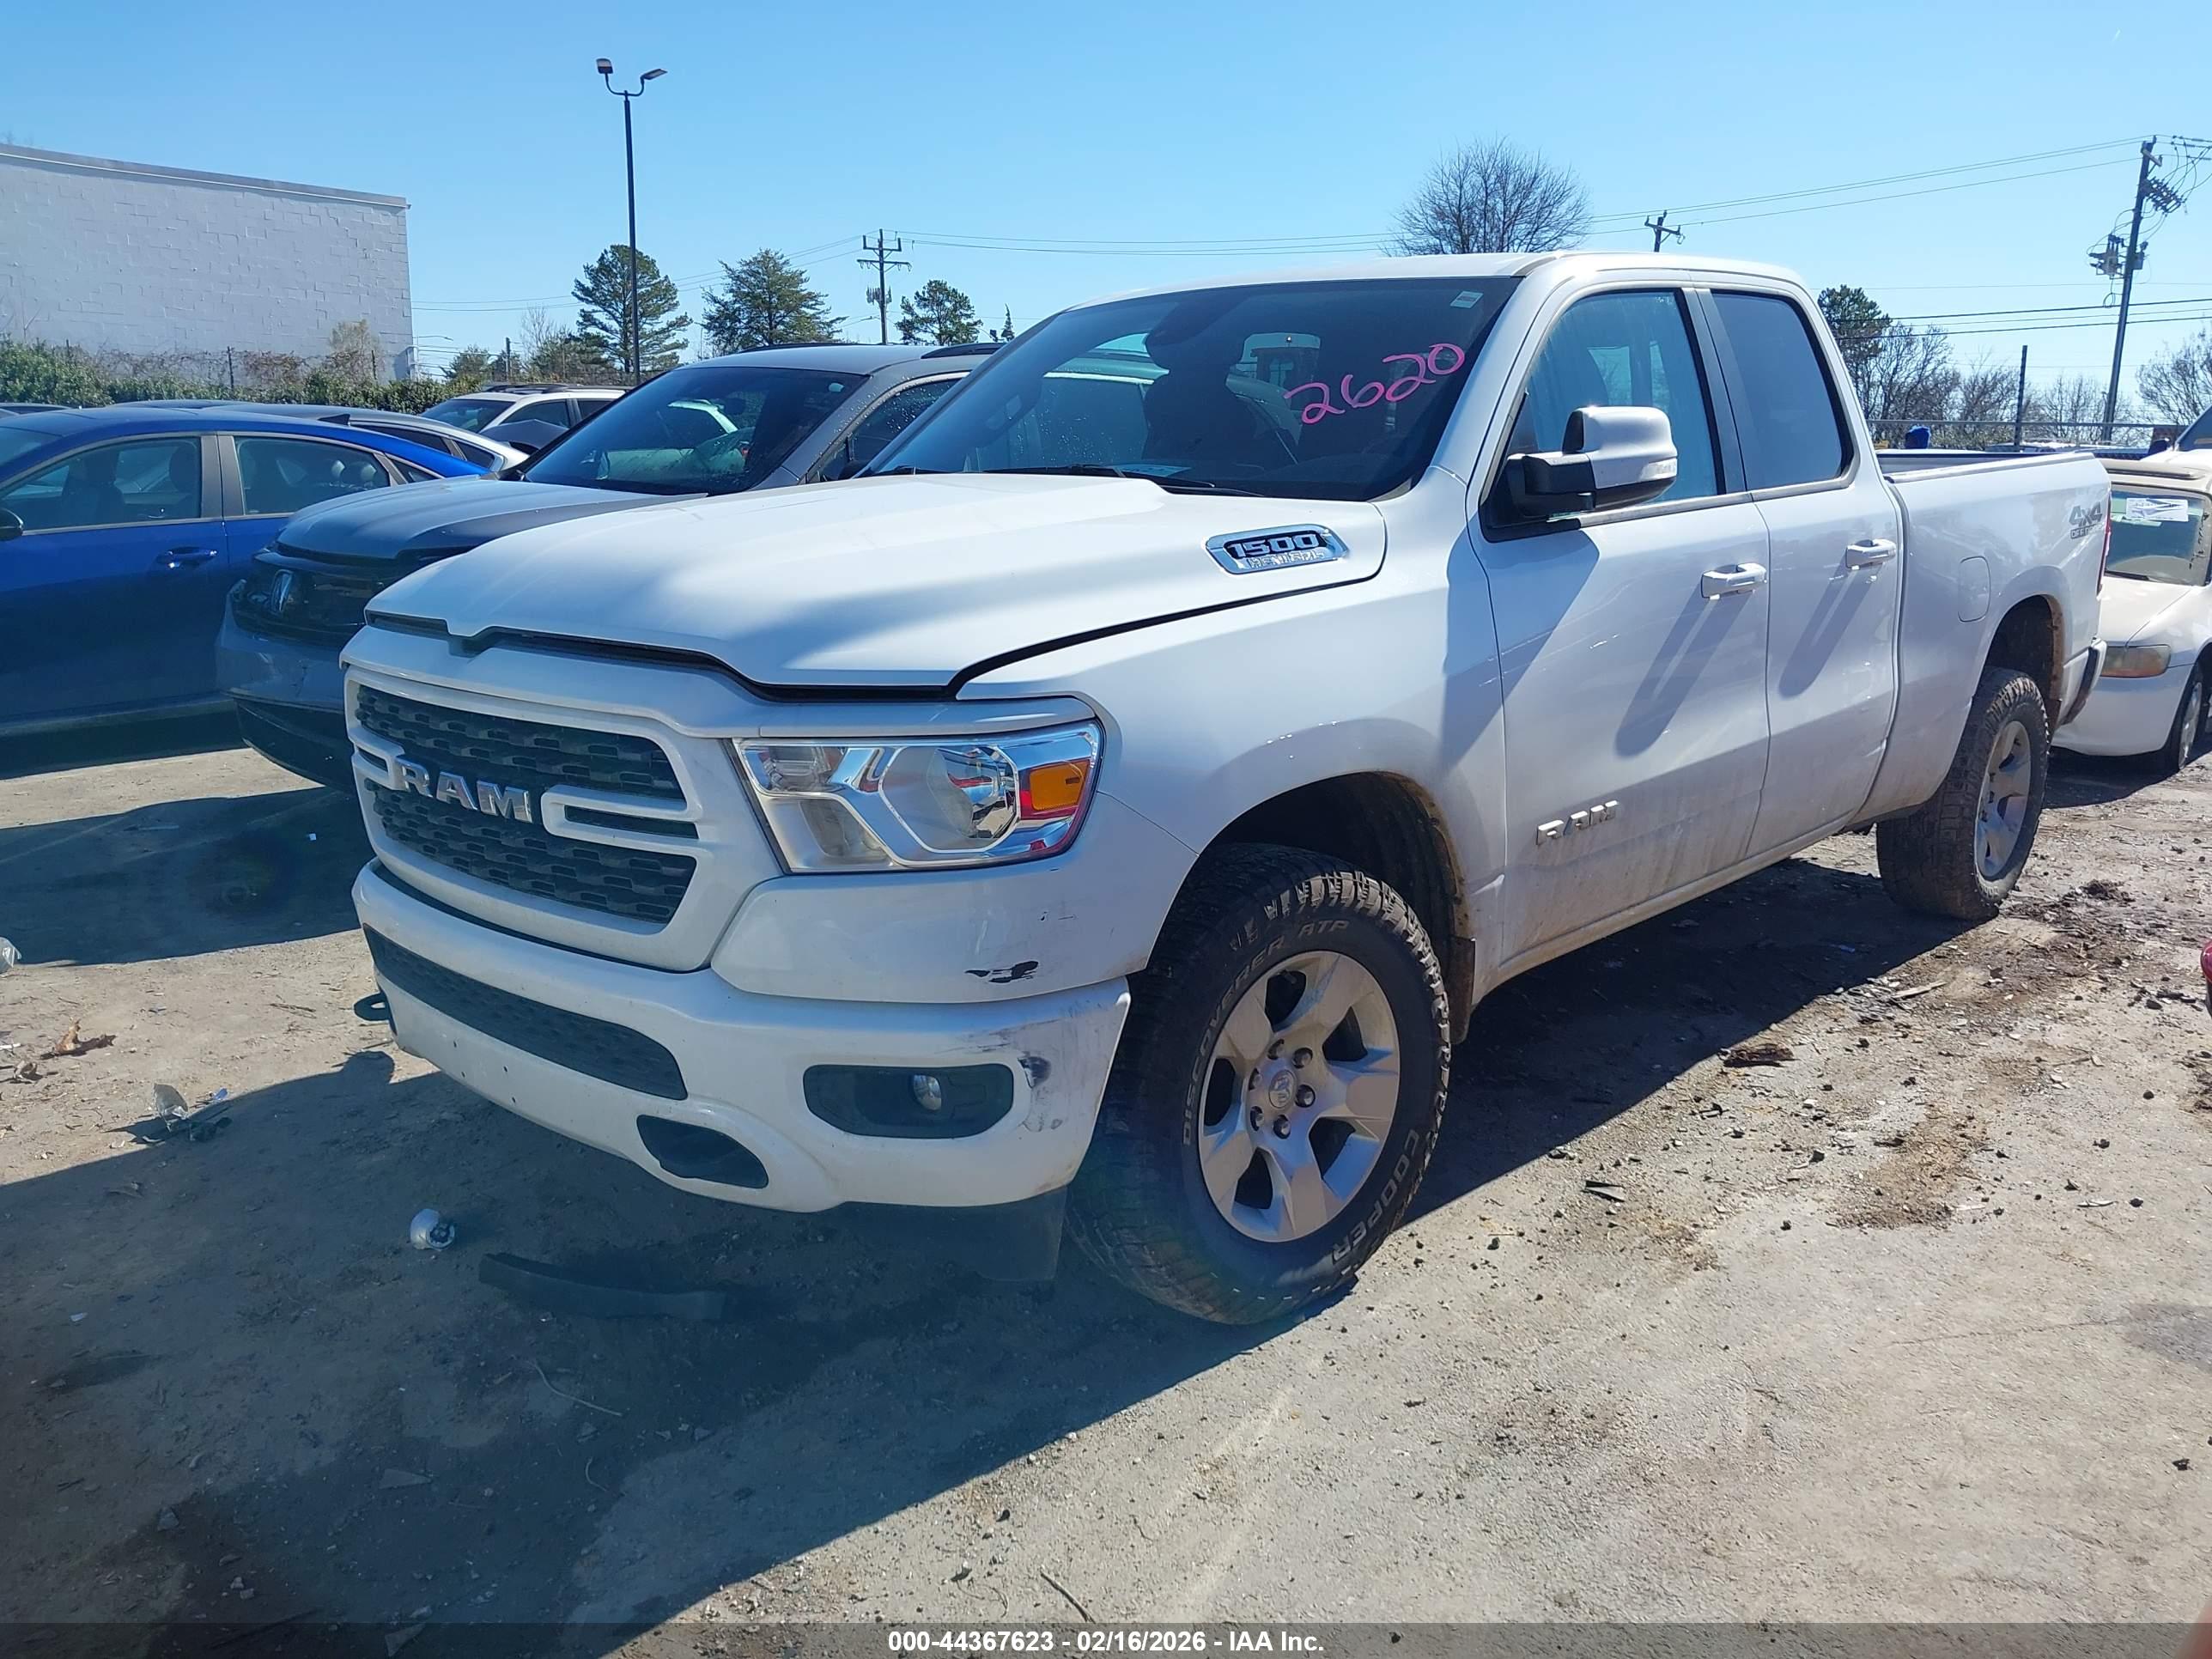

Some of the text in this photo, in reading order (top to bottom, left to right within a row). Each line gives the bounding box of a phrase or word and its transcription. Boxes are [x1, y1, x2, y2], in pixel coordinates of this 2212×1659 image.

[1283, 343, 1466, 425] 2620
[1229, 532, 1320, 558] 1500
[395, 754, 533, 823] RAM
[1535, 799, 1619, 846] RAM
[1332, 1129, 1419, 1264] COOPER
